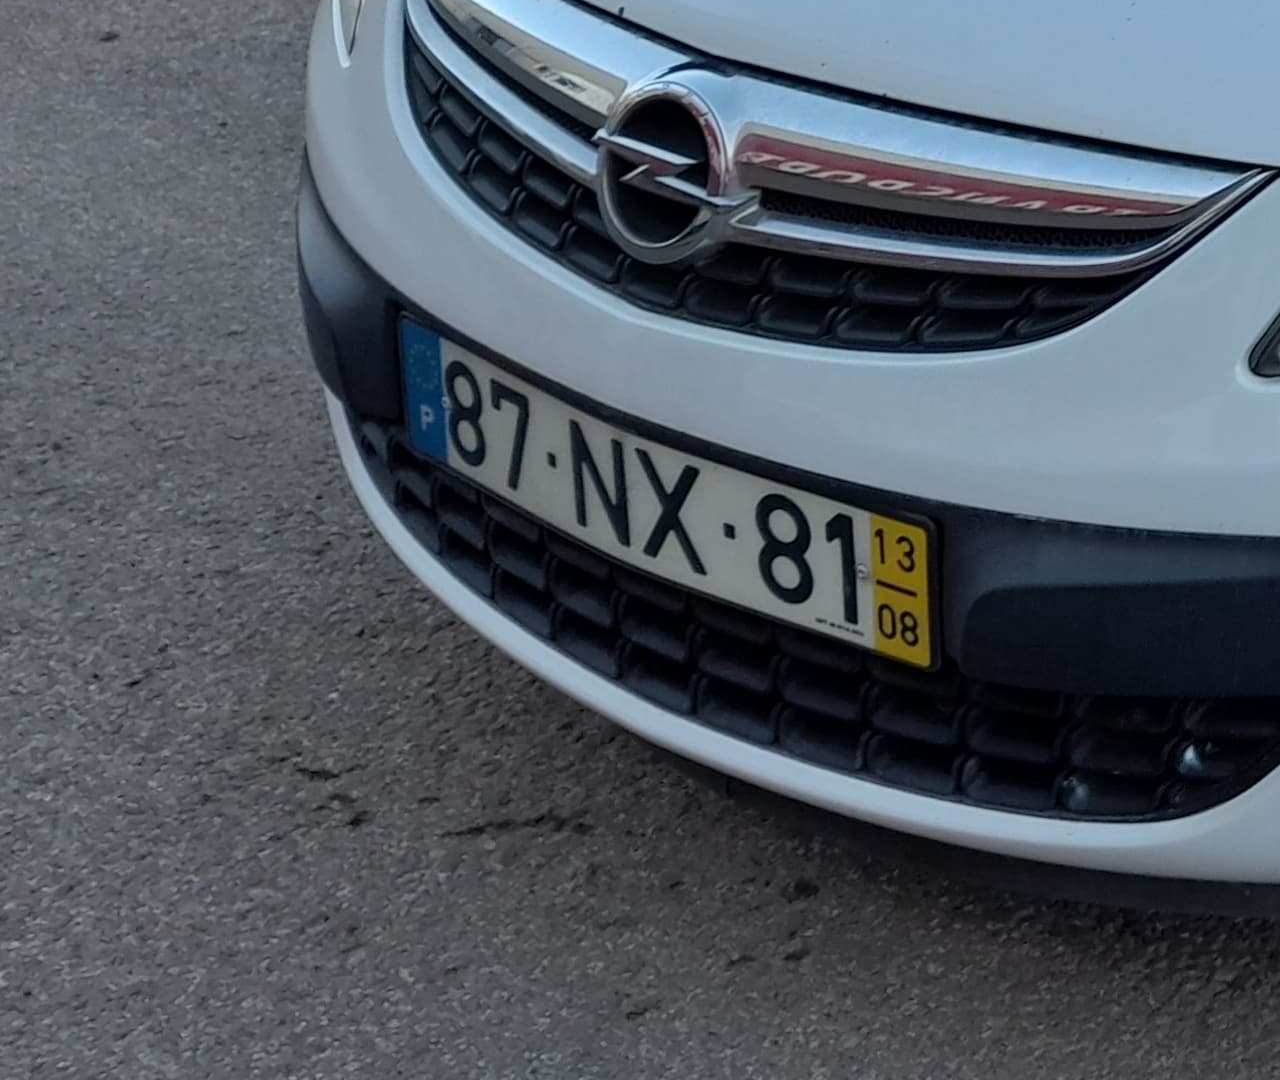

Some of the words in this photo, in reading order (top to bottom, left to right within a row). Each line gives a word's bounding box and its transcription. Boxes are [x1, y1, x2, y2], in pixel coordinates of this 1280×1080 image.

[420, 404, 434, 431] P
[873, 528, 916, 574] 13
[877, 603, 920, 649] 08
